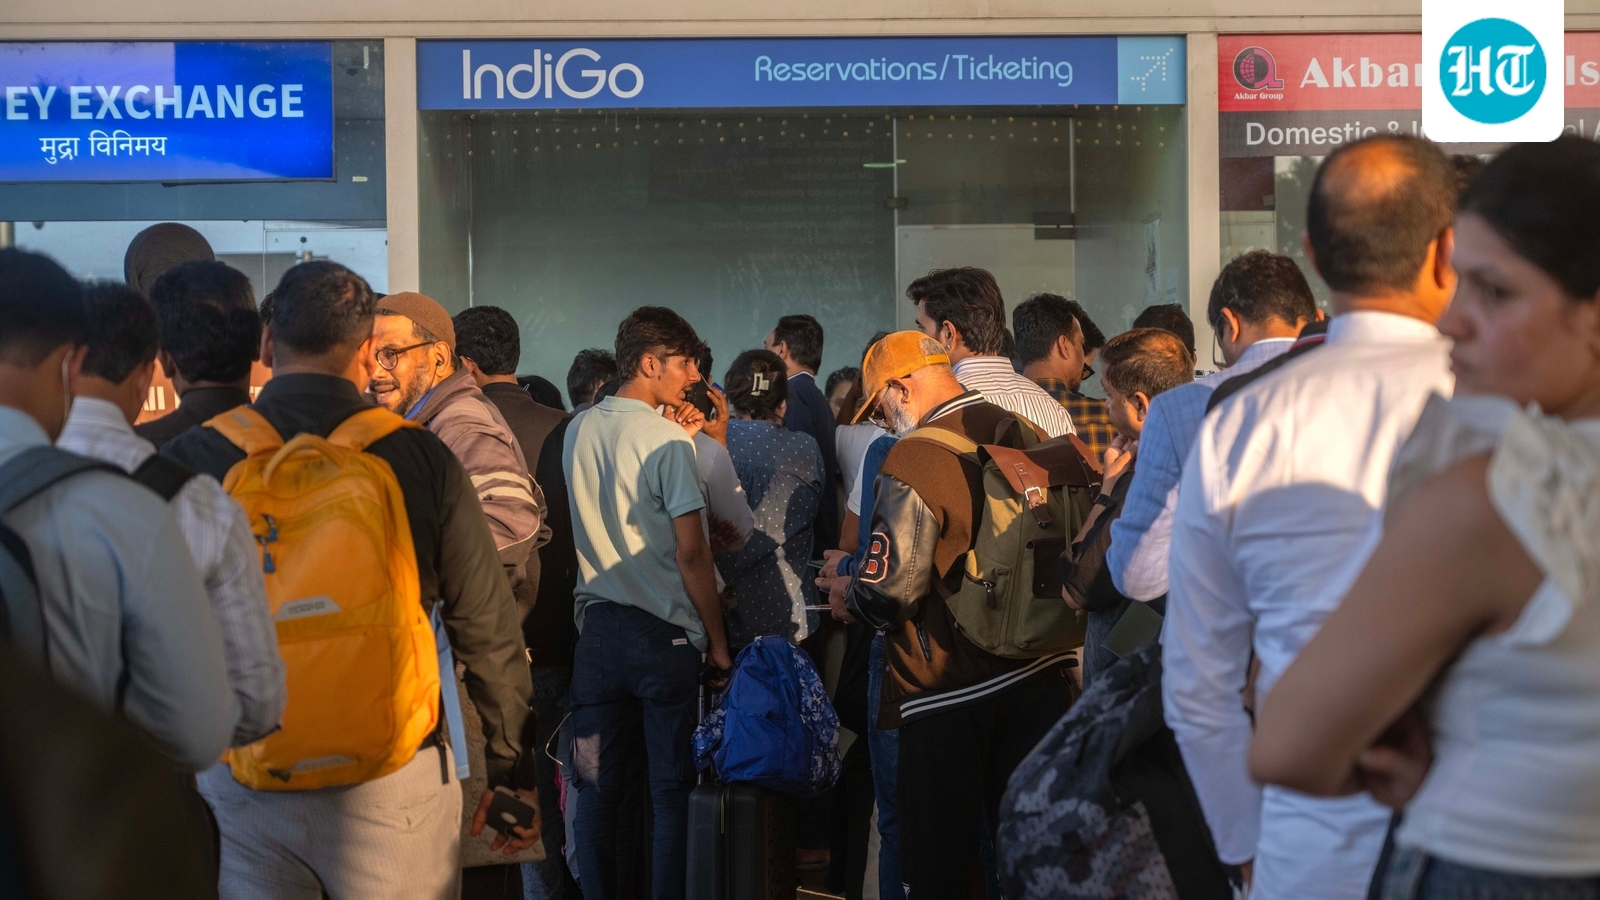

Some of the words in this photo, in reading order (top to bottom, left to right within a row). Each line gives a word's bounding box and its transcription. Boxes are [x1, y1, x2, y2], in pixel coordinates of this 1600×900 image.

[462, 48, 645, 99] IndiGo
[754, 55, 1074, 86] Reservations/Ticketing
[70, 83, 304, 119] EXCHANGE
[1234, 92, 1258, 100] Akbar
[1259, 92, 1284, 101] Group
[39, 136, 80, 164] मुद्रा
[88, 130, 168, 156] विनिमय
[1246, 121, 1377, 146] Domestic
[858, 531, 890, 584] B
